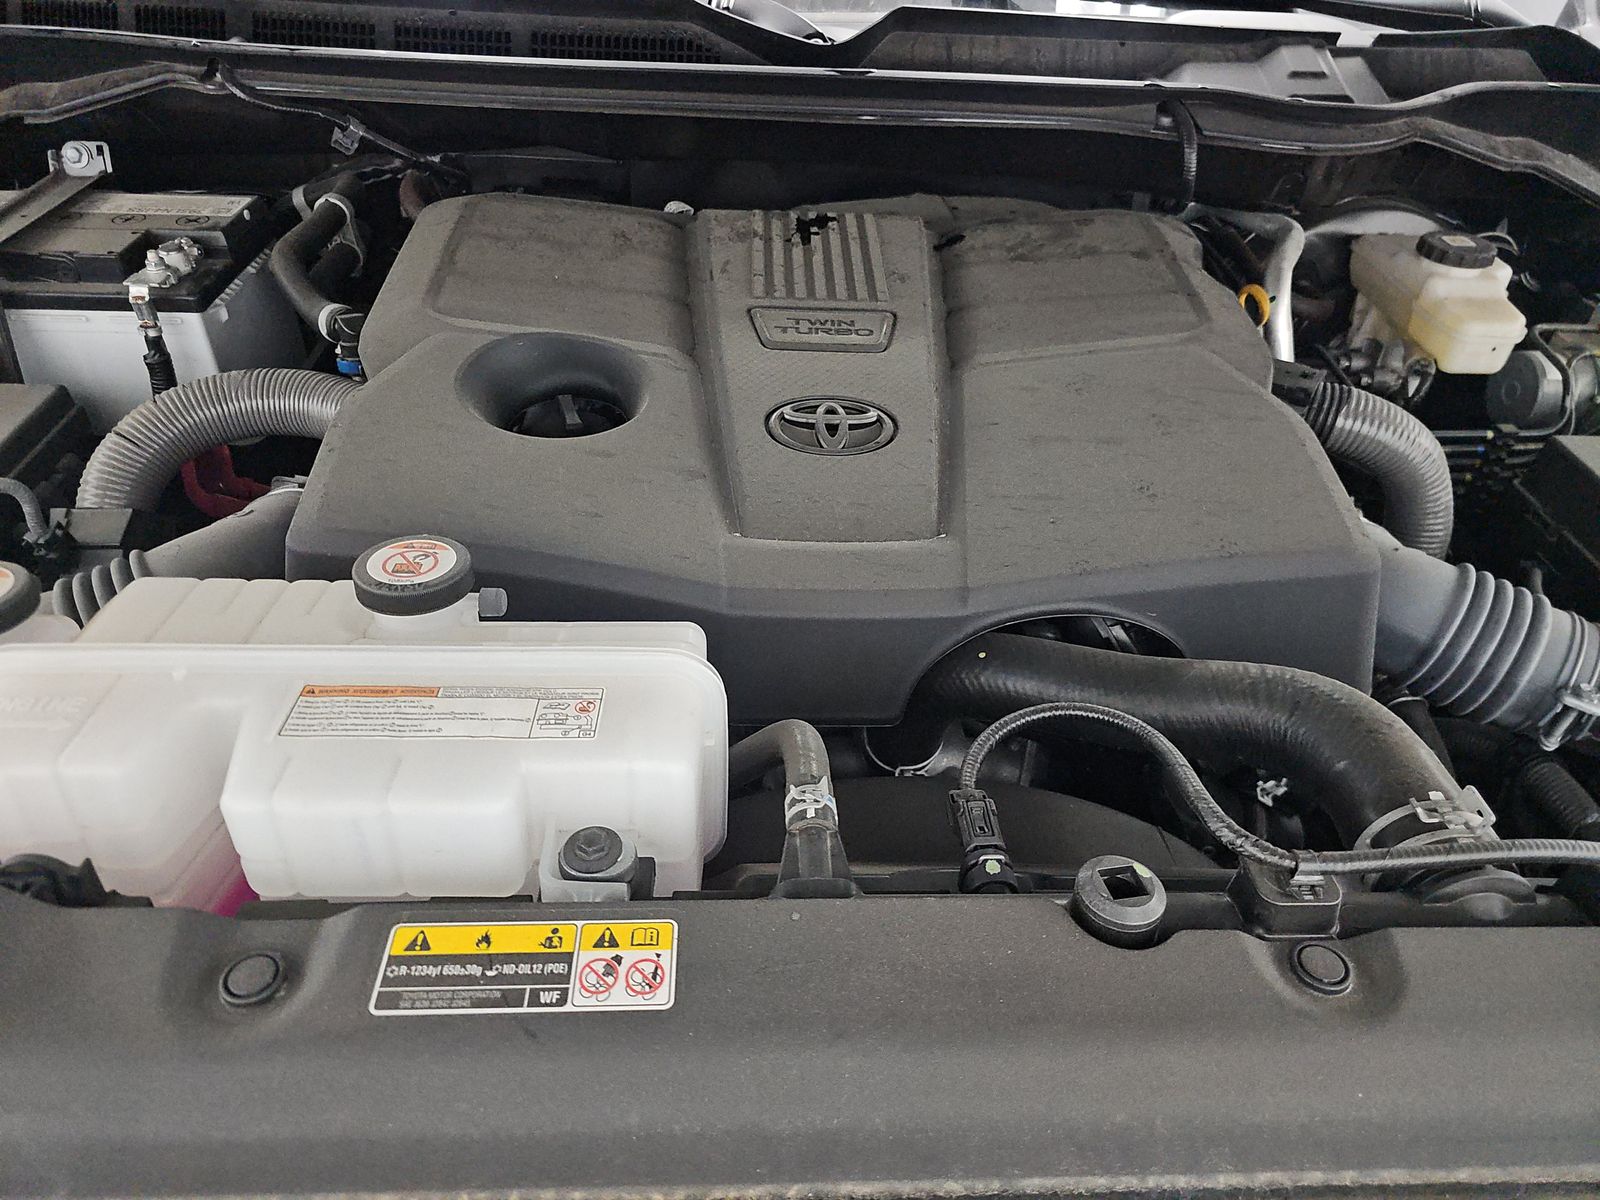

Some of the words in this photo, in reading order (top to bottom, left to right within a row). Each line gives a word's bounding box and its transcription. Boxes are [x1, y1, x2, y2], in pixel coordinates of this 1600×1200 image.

[786, 317, 855, 327] TWIN
[774, 325, 874, 337] TURBO
[544, 963, 568, 975] (POE)
[539, 991, 561, 1004] WF
